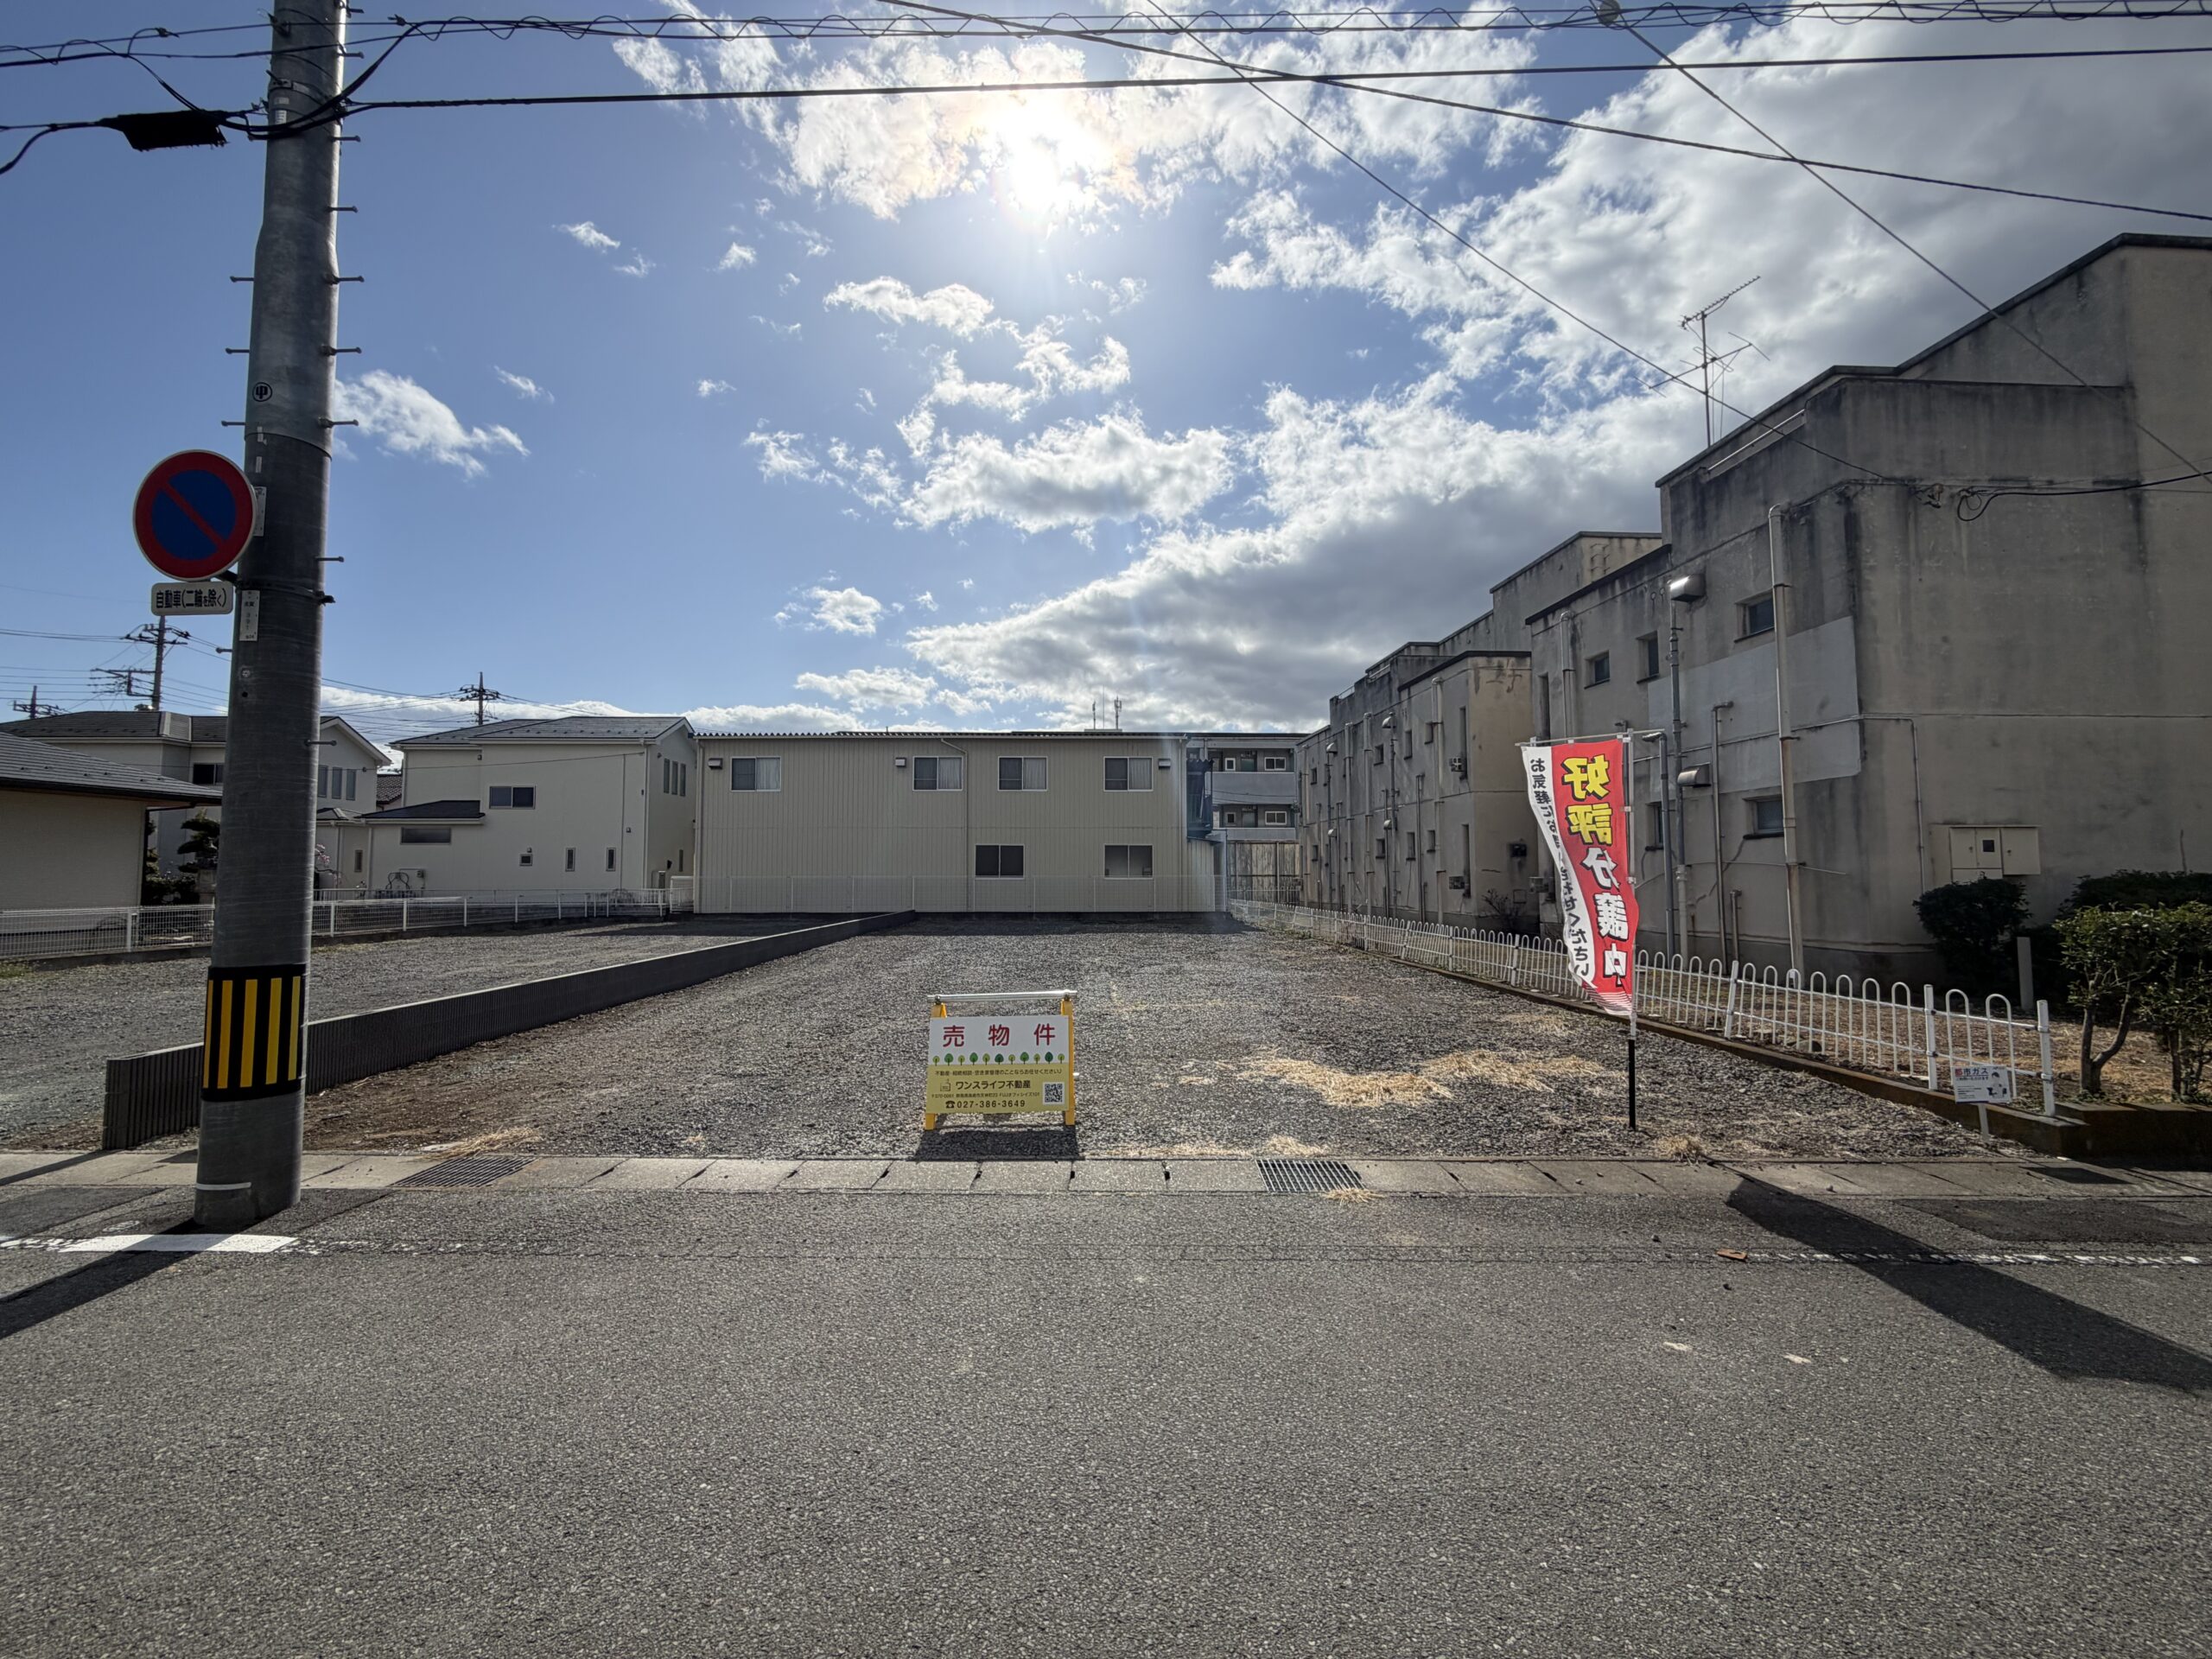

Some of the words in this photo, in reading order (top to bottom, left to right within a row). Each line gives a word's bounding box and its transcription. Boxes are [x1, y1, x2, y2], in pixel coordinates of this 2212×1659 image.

[942, 1022, 1056, 1048] 売物件
[956, 1080, 1032, 1090] ワンスライフ不動産
[957, 1099, 1027, 1109] 027-386-3649
